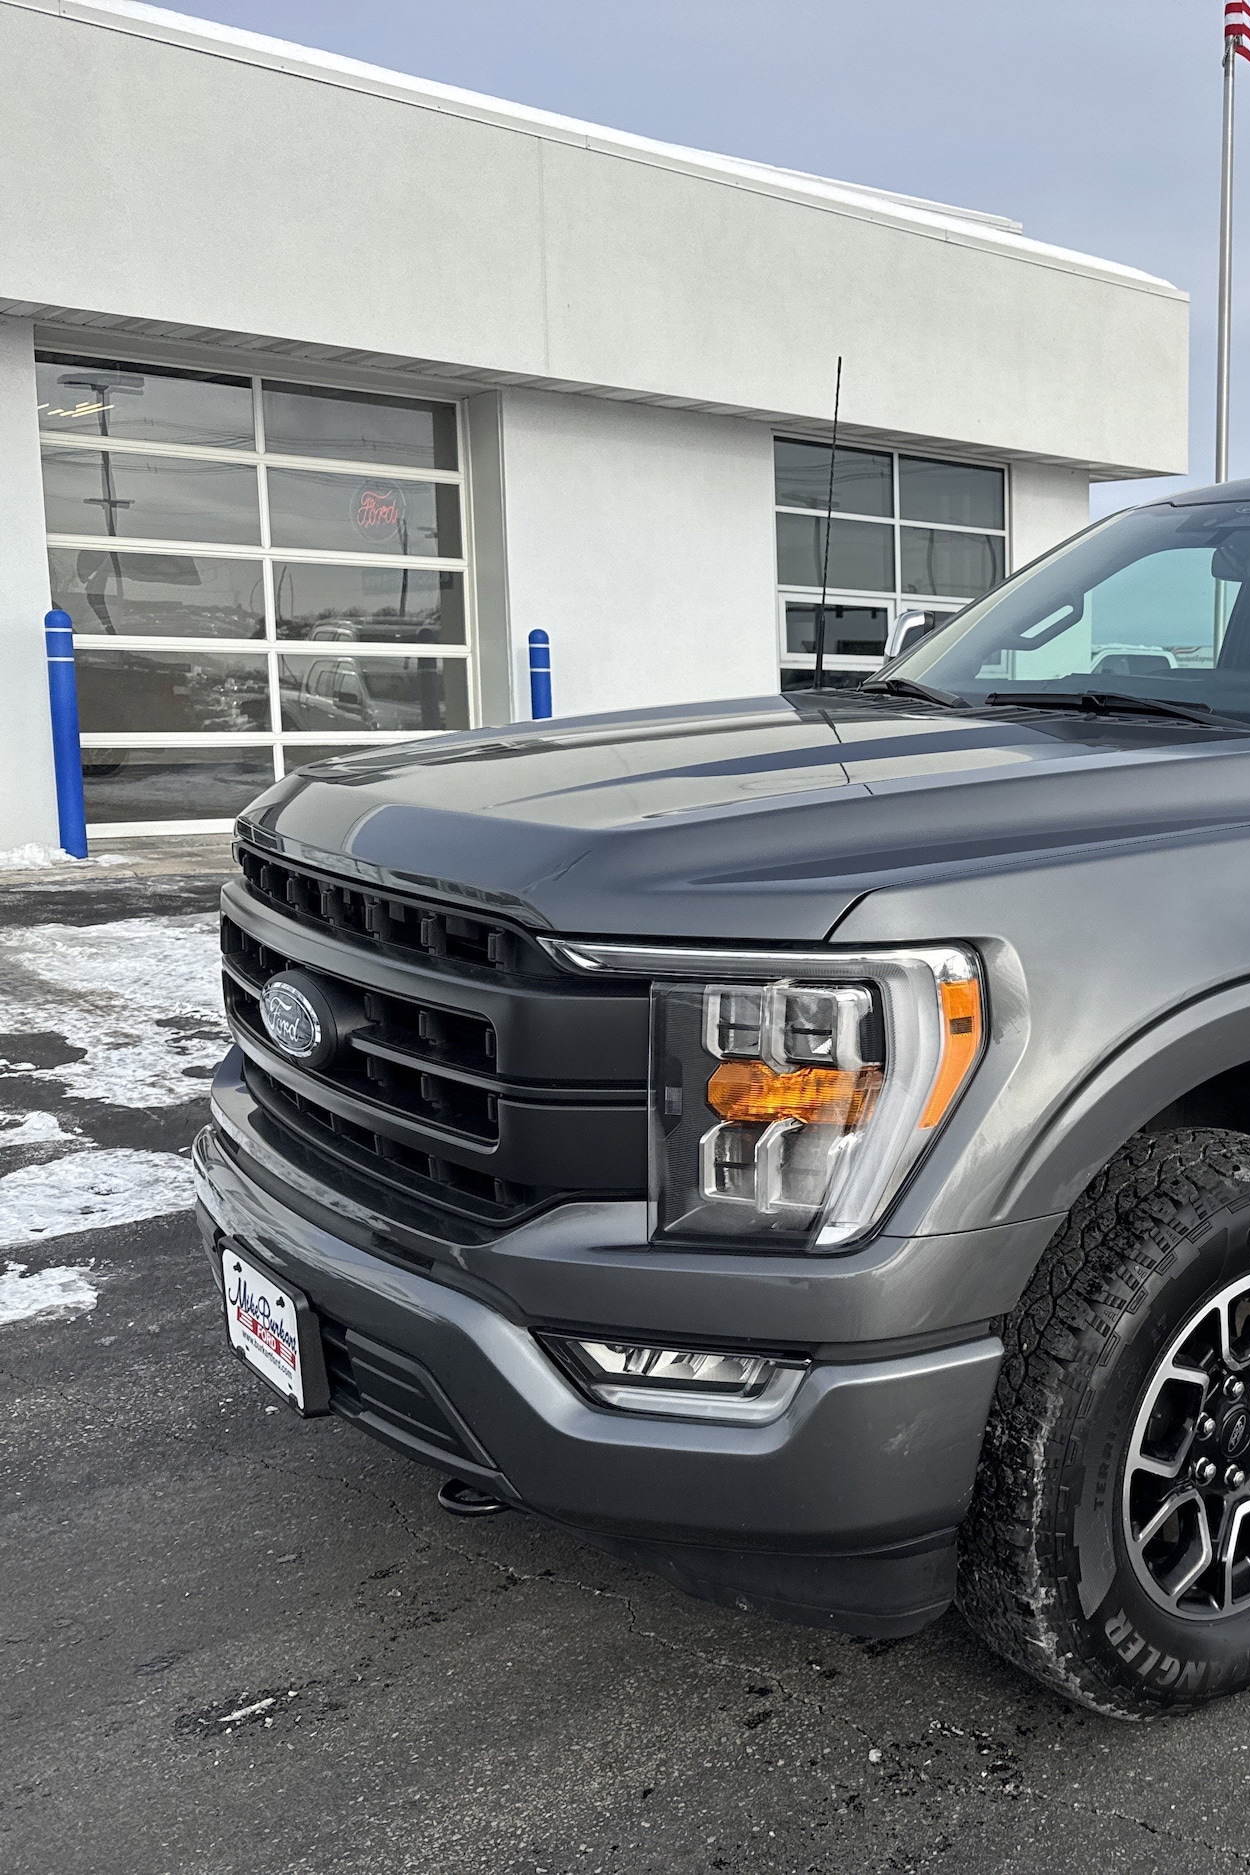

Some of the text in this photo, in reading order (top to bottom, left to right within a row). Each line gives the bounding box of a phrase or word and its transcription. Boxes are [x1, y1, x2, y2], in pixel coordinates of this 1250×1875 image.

[357, 490, 398, 528] Ford
[267, 996, 301, 1042] Ford
[228, 1276, 260, 1320] Mike
[257, 1327, 277, 1350] FORD
